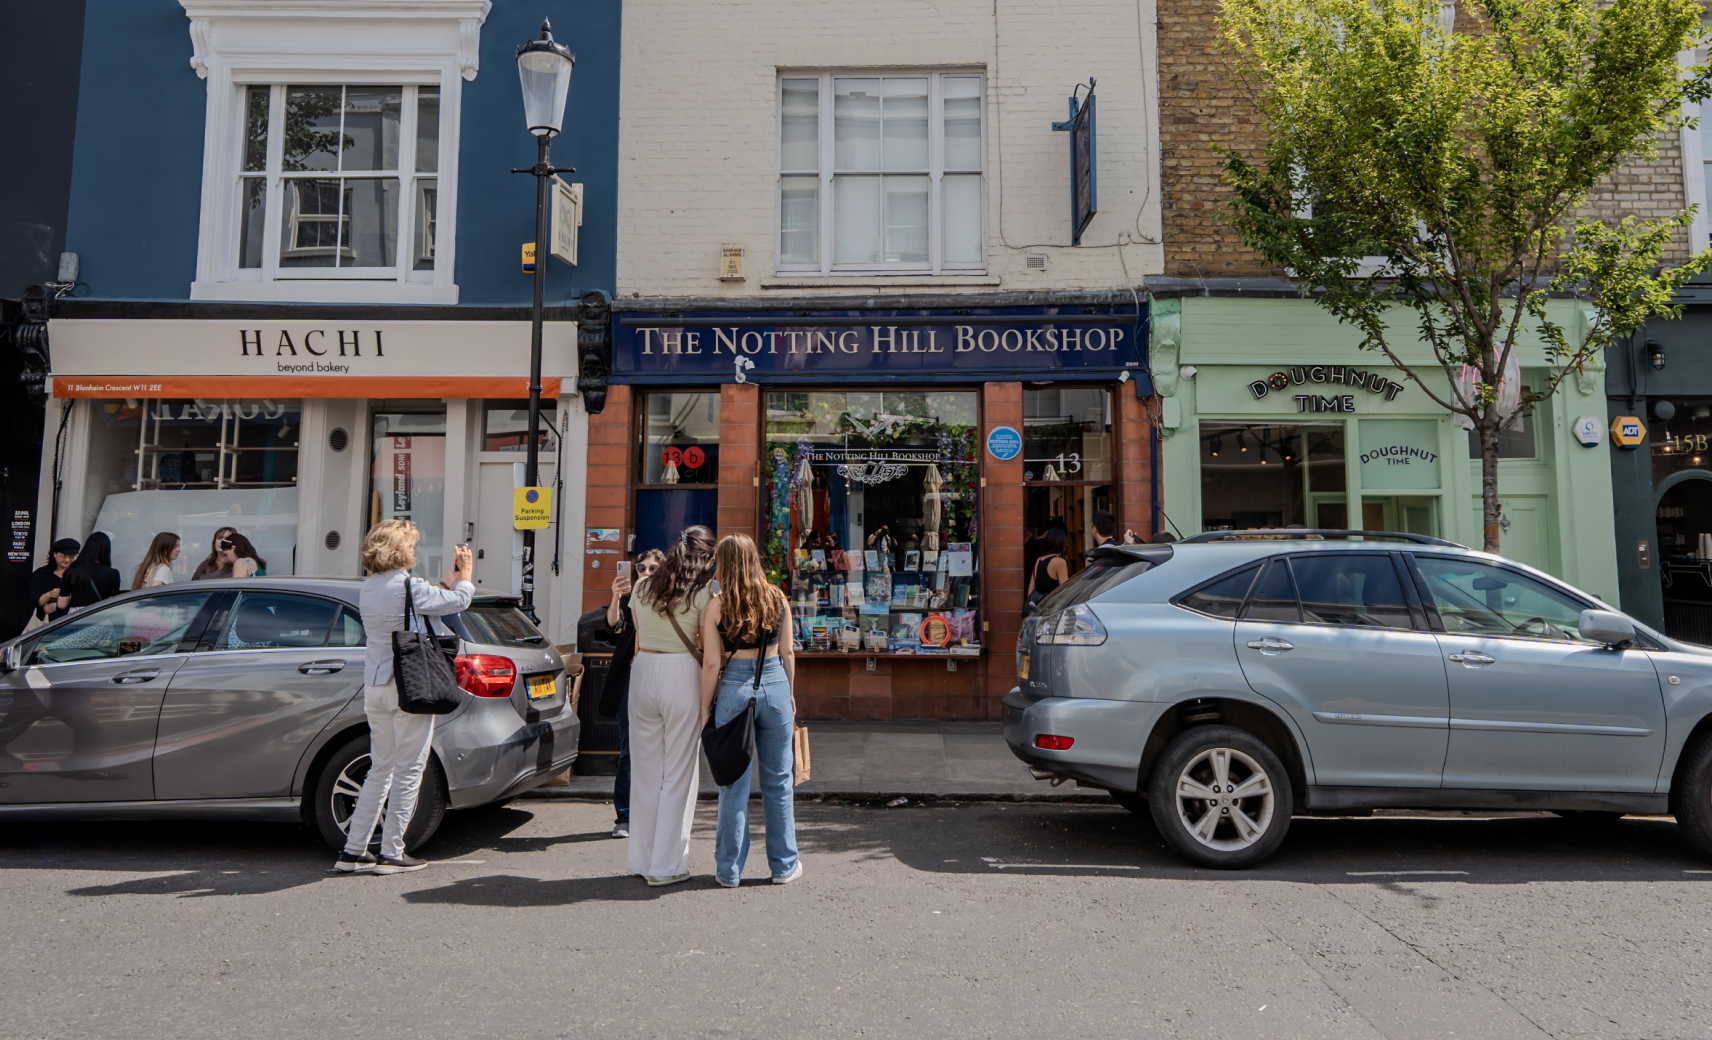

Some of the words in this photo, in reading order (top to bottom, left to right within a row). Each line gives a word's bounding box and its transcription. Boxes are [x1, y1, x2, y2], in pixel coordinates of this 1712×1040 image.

[239, 329, 385, 357] HACHI
[635, 327, 703, 355] THE
[712, 327, 860, 355] NOTTING
[871, 326, 944, 353] HILL
[955, 325, 1125, 353] BOOKSHOP
[277, 361, 314, 374] beyond
[316, 361, 350, 374] bakery
[1247, 365, 1405, 401] DOUGHNUT
[1292, 394, 1355, 413] TIME
[1622, 426, 1639, 436] ADT
[1673, 434, 1708, 453] 15B
[398, 454, 406, 471] SDM
[805, 452, 824, 460] THE
[825, 452, 867, 460] NOTTING
[869, 451, 889, 460] HILL
[892, 452, 940, 460] BOOKSHOP
[1055, 452, 1081, 474] 13
[1360, 445, 1438, 465] DOUGHNUT
[1386, 457, 1411, 466] TIME
[395, 473, 407, 511] Leyland
